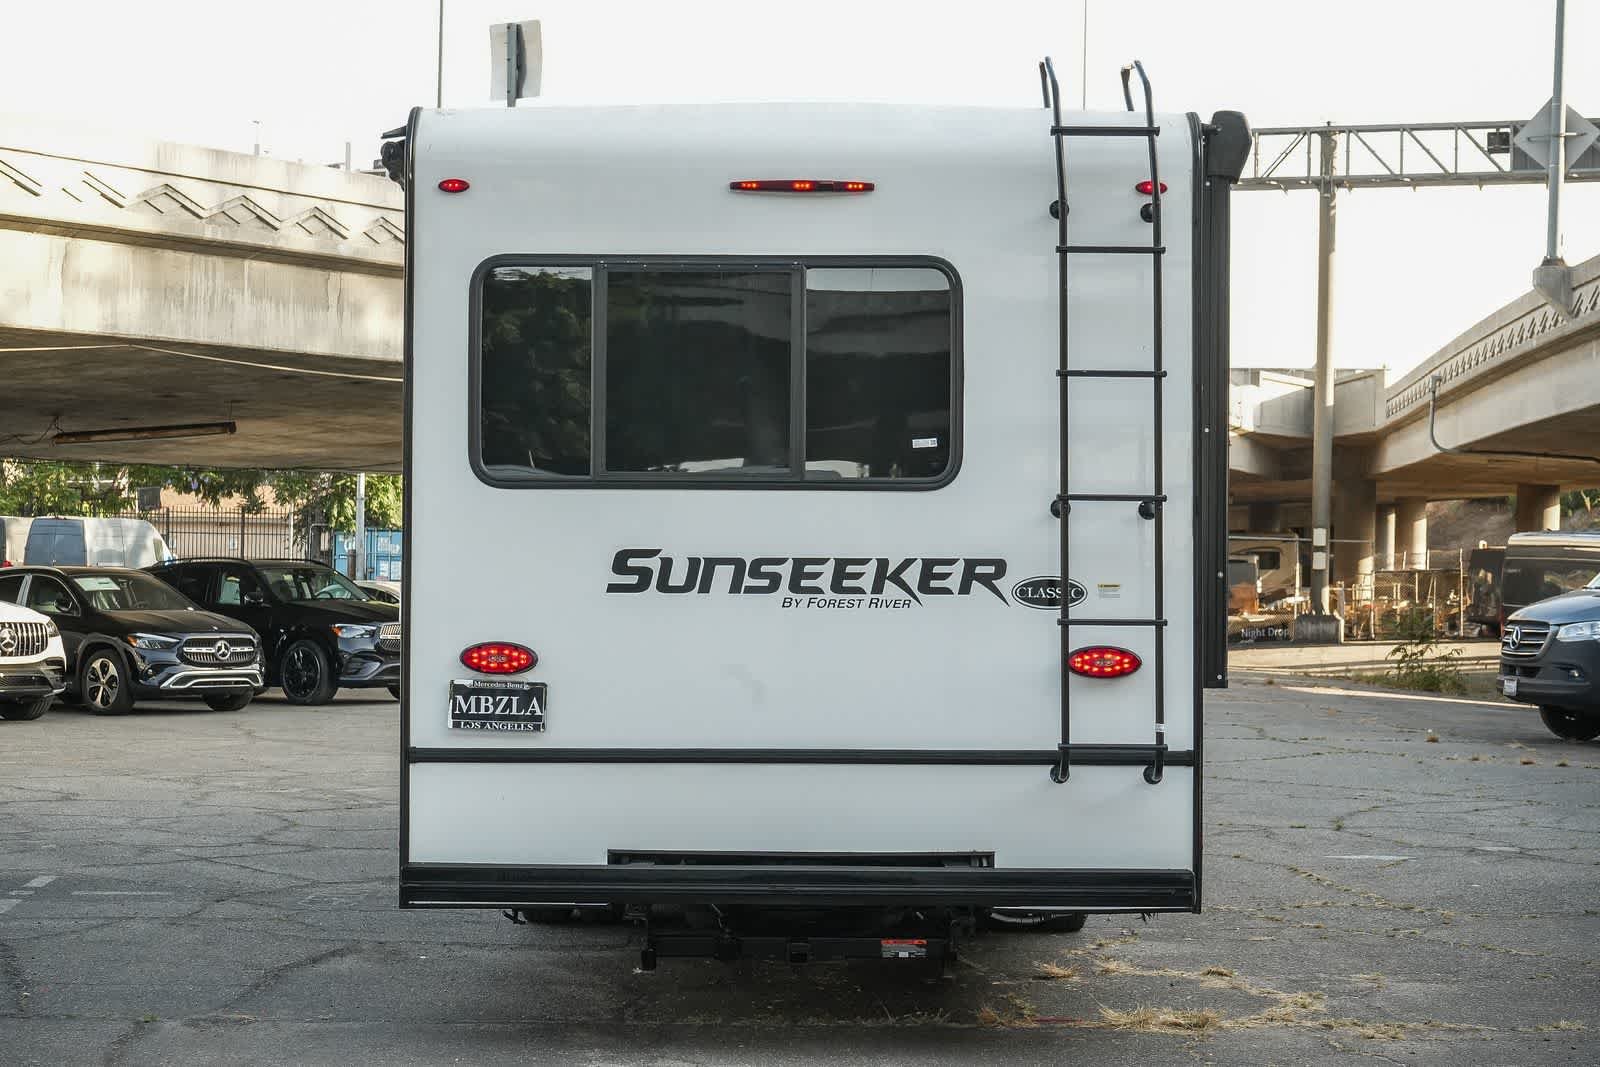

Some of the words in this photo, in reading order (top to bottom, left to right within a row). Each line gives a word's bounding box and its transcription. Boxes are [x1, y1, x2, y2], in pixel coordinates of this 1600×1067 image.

[1016, 587, 1082, 599] CLASSC
[807, 597, 865, 609] FOREST
[868, 597, 912, 609] RIVER
[1241, 628, 1265, 640] Night
[454, 695, 544, 716] MBZLA
[484, 722, 534, 731] ANGELES
